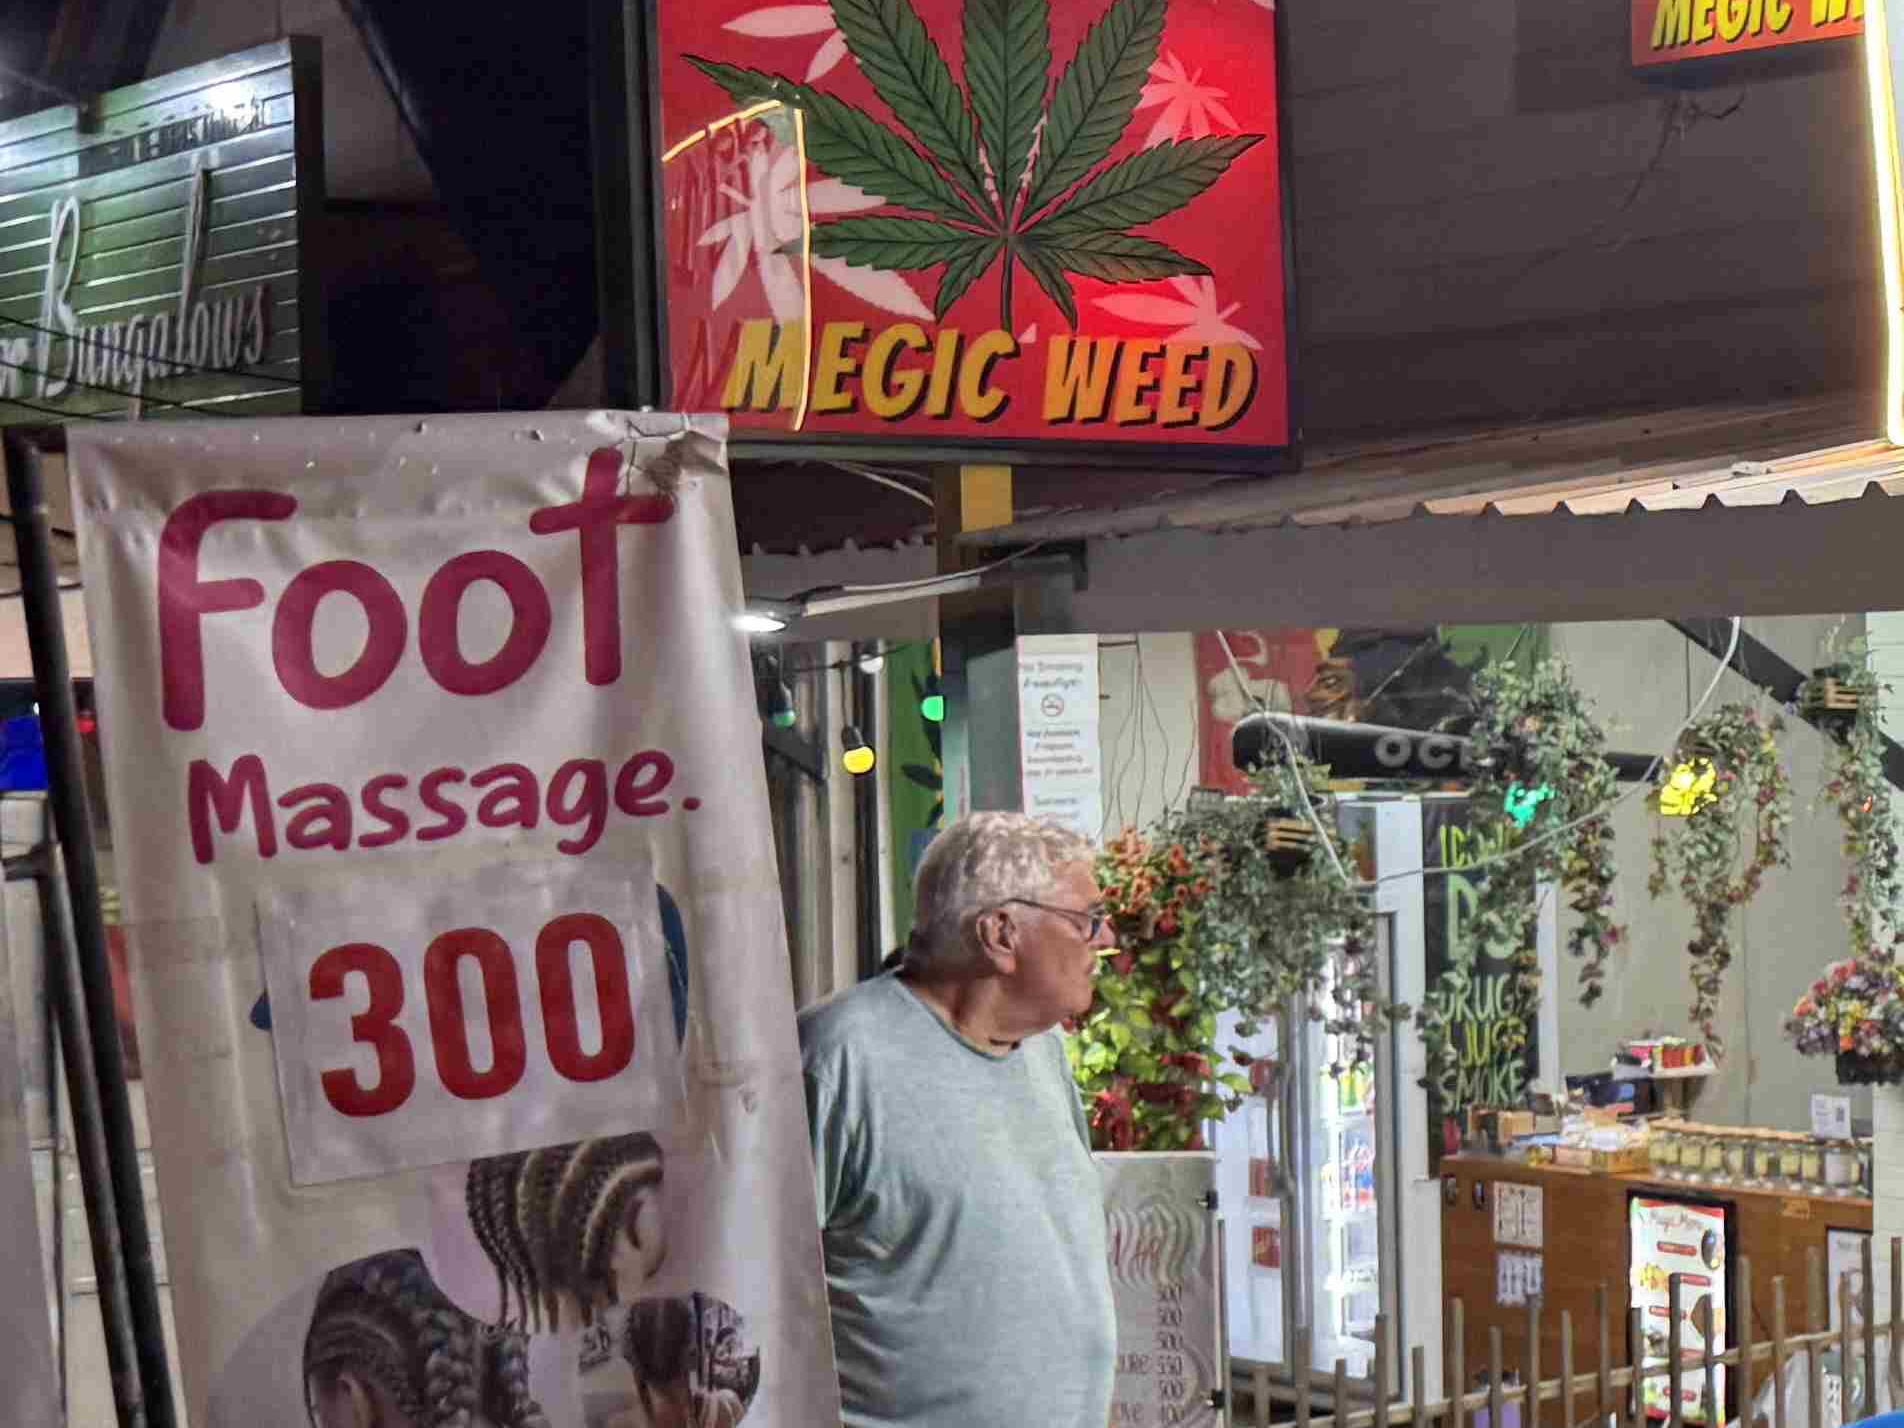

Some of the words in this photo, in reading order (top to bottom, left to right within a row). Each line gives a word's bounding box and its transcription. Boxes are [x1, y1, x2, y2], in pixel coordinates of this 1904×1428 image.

[720, 317, 1018, 419] MEGIC
[1041, 333, 1259, 429] WEED
[158, 447, 674, 732] Foot
[189, 748, 702, 865] Massage.
[309, 911, 635, 1118] 300
